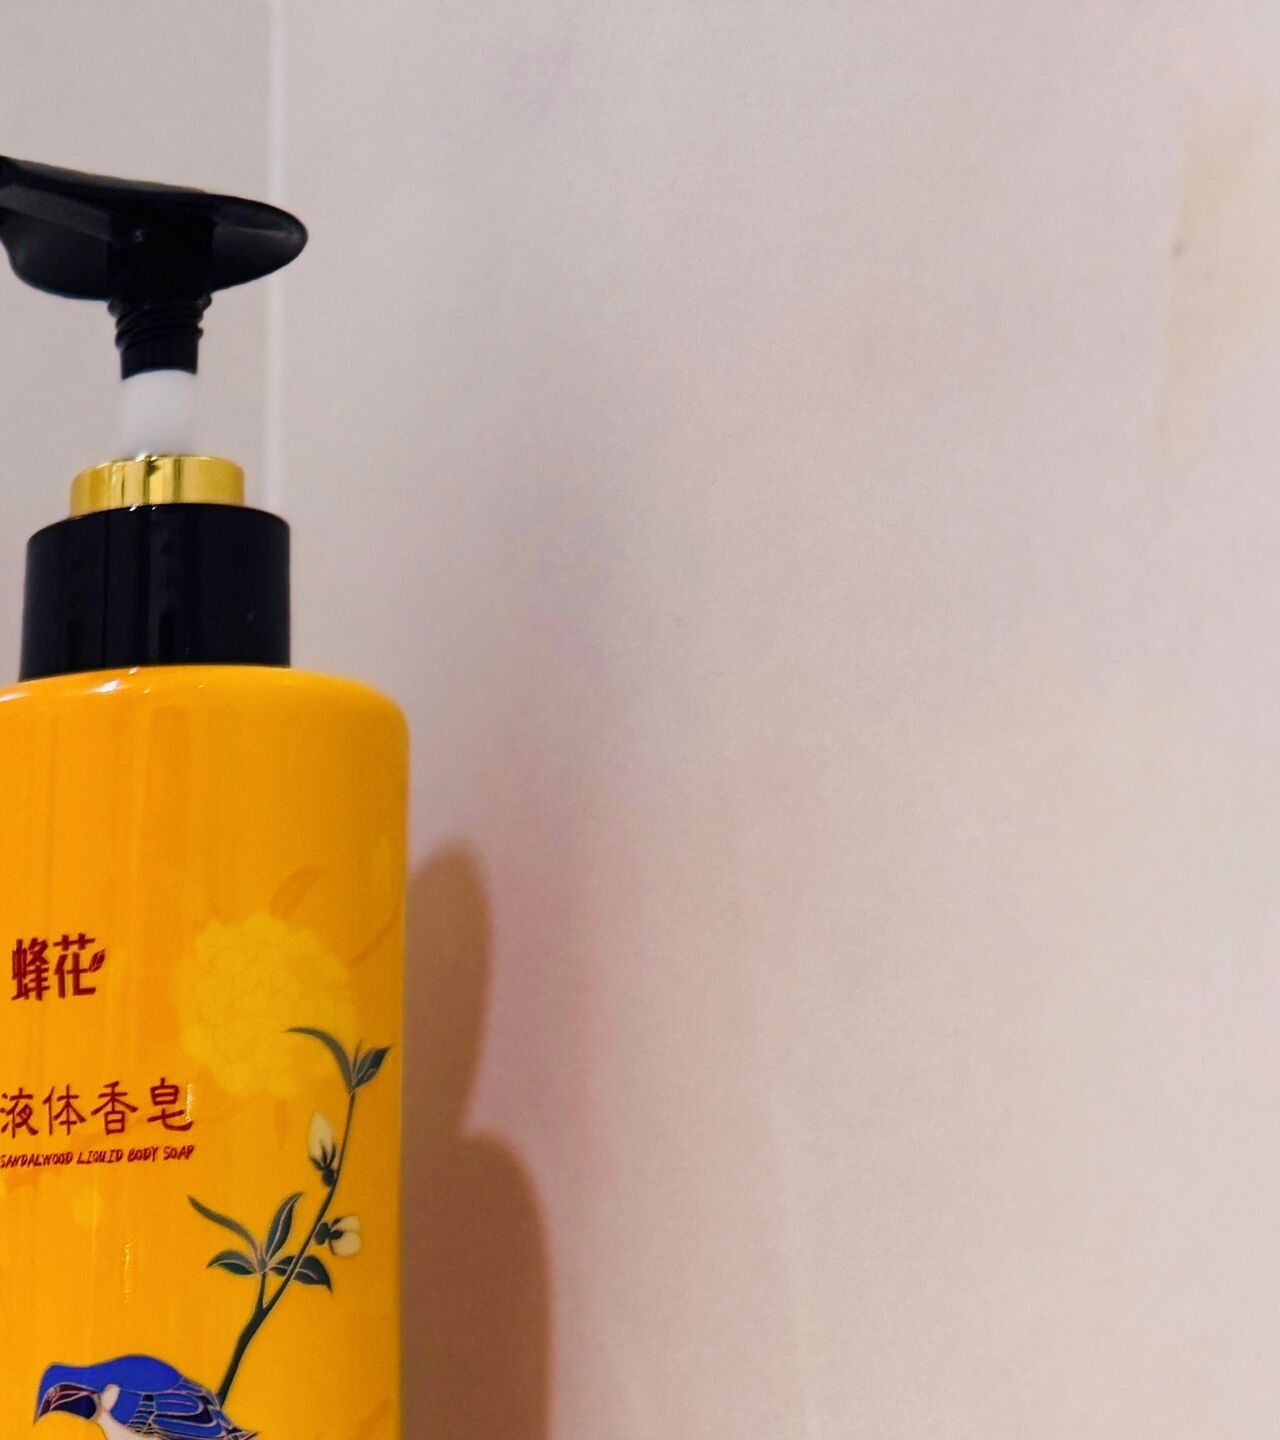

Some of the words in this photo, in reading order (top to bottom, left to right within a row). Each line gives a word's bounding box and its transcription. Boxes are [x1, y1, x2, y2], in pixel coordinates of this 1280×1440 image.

[10, 932, 106, 1001] 蜂花
[0, 1077, 194, 1139] 液体香皂
[0, 1152, 73, 1168] SANDALWOOD
[76, 1149, 124, 1165] LIQUID
[127, 1146, 159, 1163] BODY
[163, 1144, 195, 1161] SOAP
